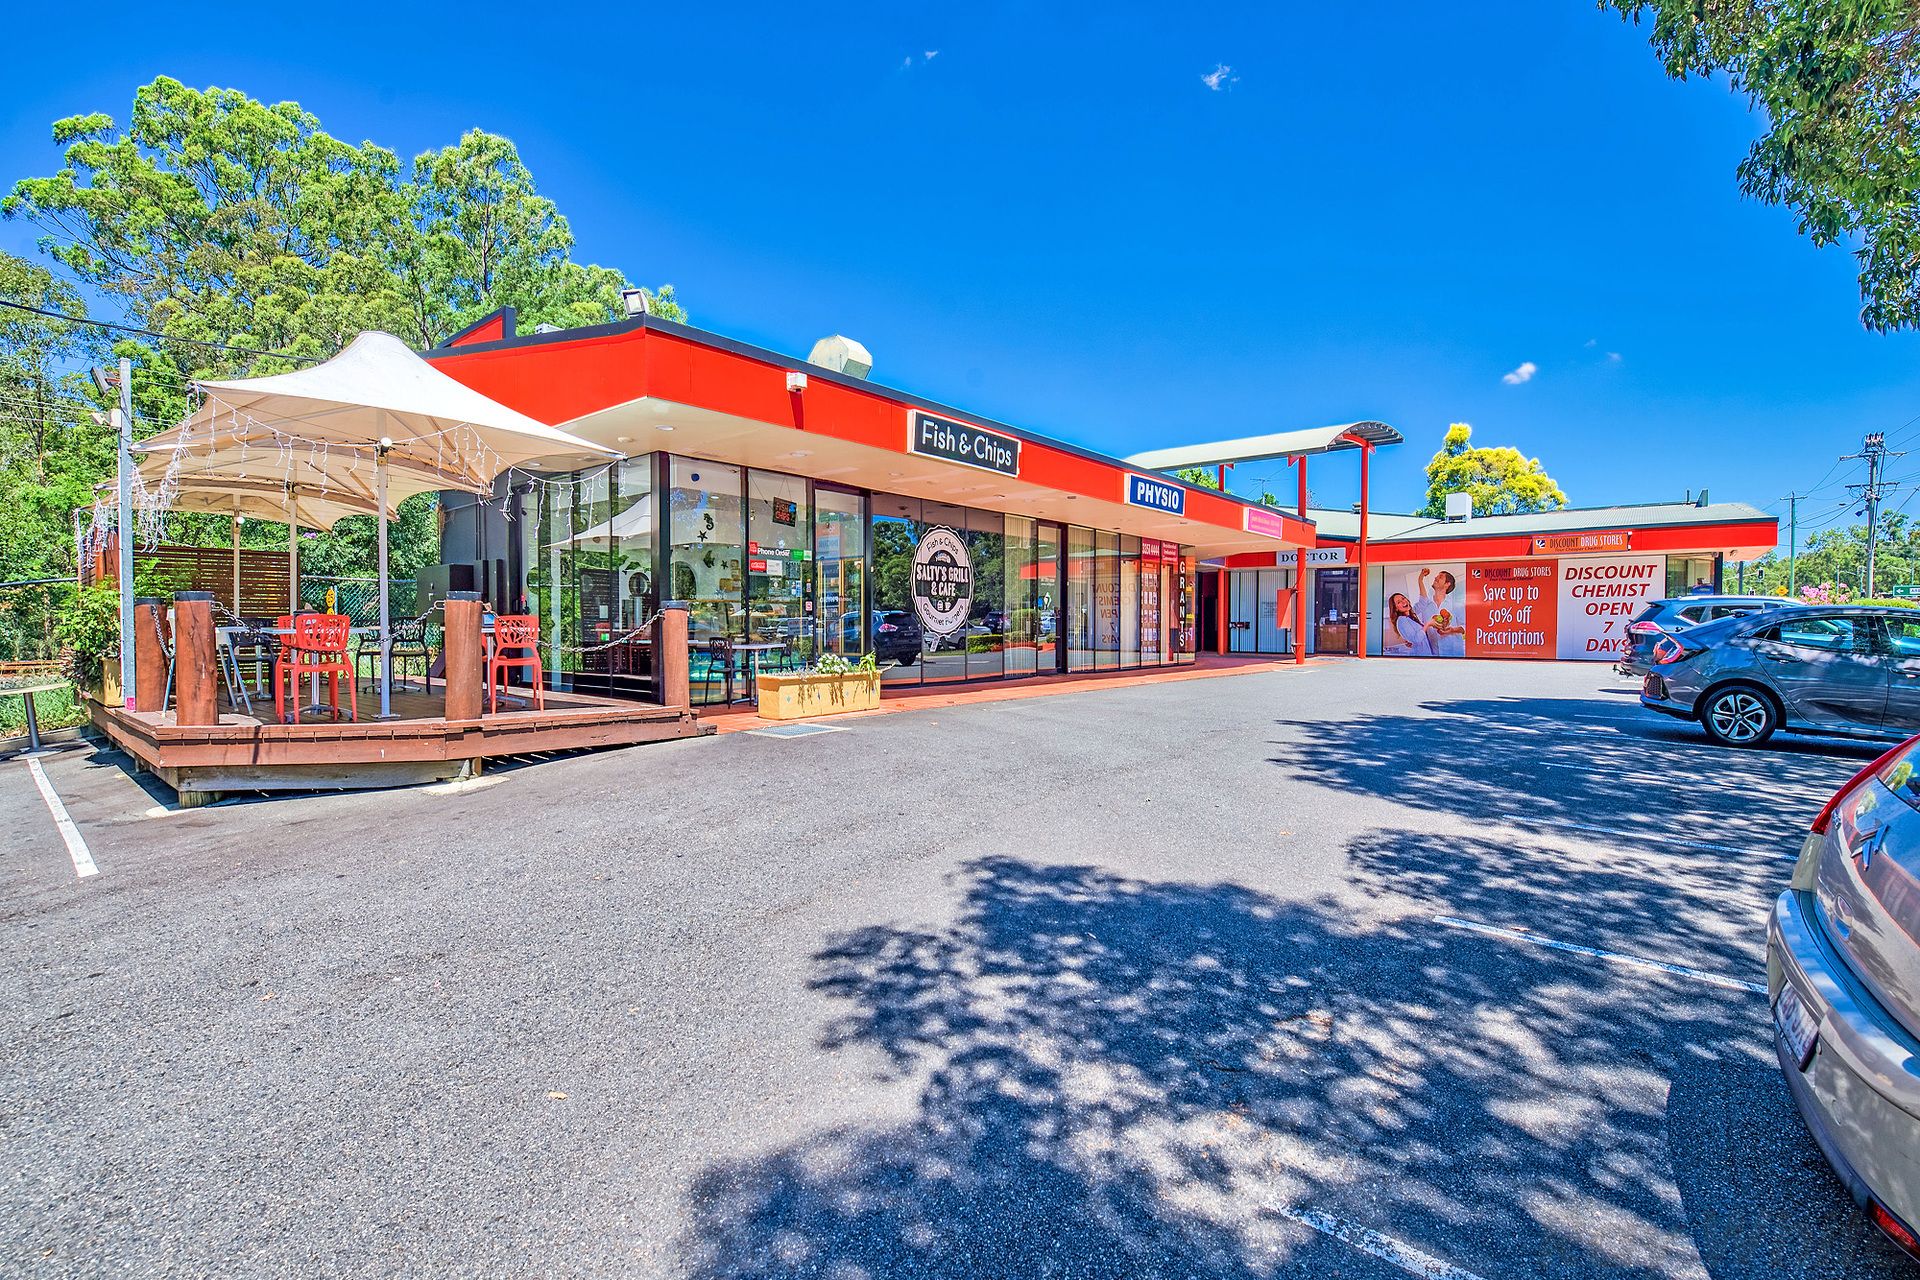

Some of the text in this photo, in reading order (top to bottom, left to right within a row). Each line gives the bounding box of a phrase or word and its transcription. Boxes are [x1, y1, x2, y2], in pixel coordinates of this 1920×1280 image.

[921, 419, 1012, 468] Fish & Chips
[1136, 481, 1180, 510] PHYSIO
[926, 538, 939, 552] Fish
[944, 536, 959, 555] Chips
[1549, 534, 1623, 549] DISCOUNT DRUG STORES
[757, 547, 774, 556] Phone
[774, 548, 791, 557] Order
[916, 564, 969, 583] SALTY'S GRILL
[1484, 566, 1552, 578] DISCOUNT DRUG STORES
[1565, 564, 1657, 580] DISCOUNT
[931, 581, 956, 597] & CAFE
[1483, 583, 1539, 604] Save up to
[1571, 583, 1650, 598] CHEMIST
[922, 602, 944, 626] Gourmet
[1488, 605, 1533, 627] 50% off
[1585, 602, 1634, 616] OPEN
[1603, 621, 1615, 634] 7
[1476, 627, 1545, 649] Prescriptions
